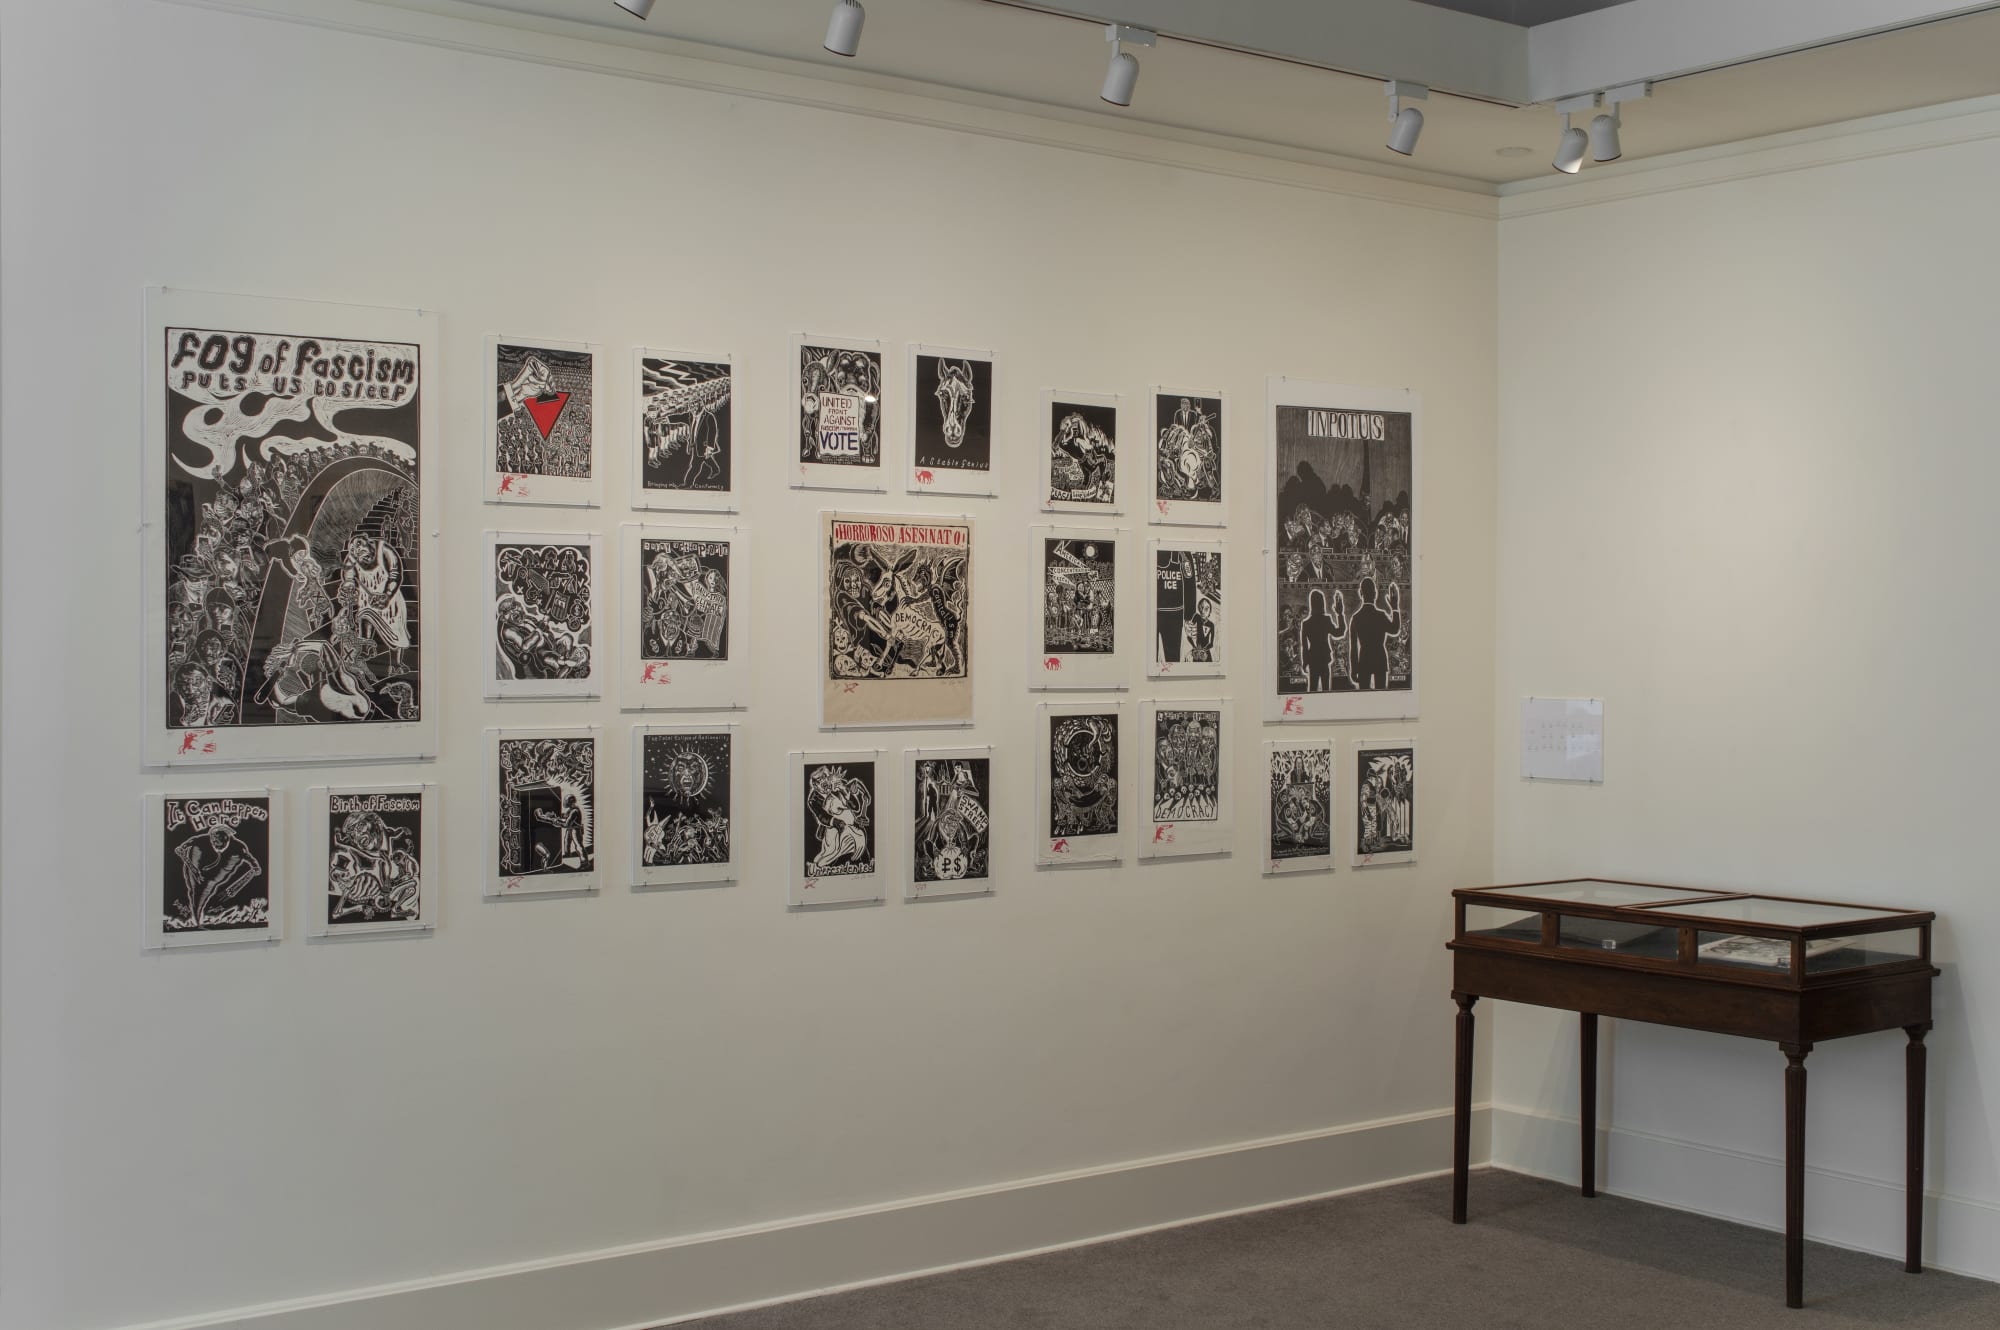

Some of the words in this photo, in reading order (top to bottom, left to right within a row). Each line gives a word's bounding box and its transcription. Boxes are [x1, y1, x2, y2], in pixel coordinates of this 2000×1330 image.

[259, 339, 290, 374] of
[272, 375, 302, 395] us
[313, 378, 337, 397] to
[340, 380, 408, 402] sleep
[822, 396, 853, 409] UNITED
[824, 415, 857, 426] AGAINST
[1310, 410, 1382, 440] IMPOTUS
[819, 431, 858, 451] VOTE
[1157, 570, 1182, 580] POLICE
[1164, 580, 1177, 590] ICE
[895, 612, 945, 642] DEMOCRACY
[331, 796, 361, 812] Birth
[362, 797, 377, 811] of
[377, 795, 420, 812] Fascism
[962, 795, 988, 825] SWAMP
[1155, 804, 1214, 819] DEMOCRACY
[167, 801, 186, 831] It
[186, 800, 221, 817] Can
[222, 800, 268, 820] Happen
[192, 815, 240, 832] Here
[959, 803, 985, 830] STREET
